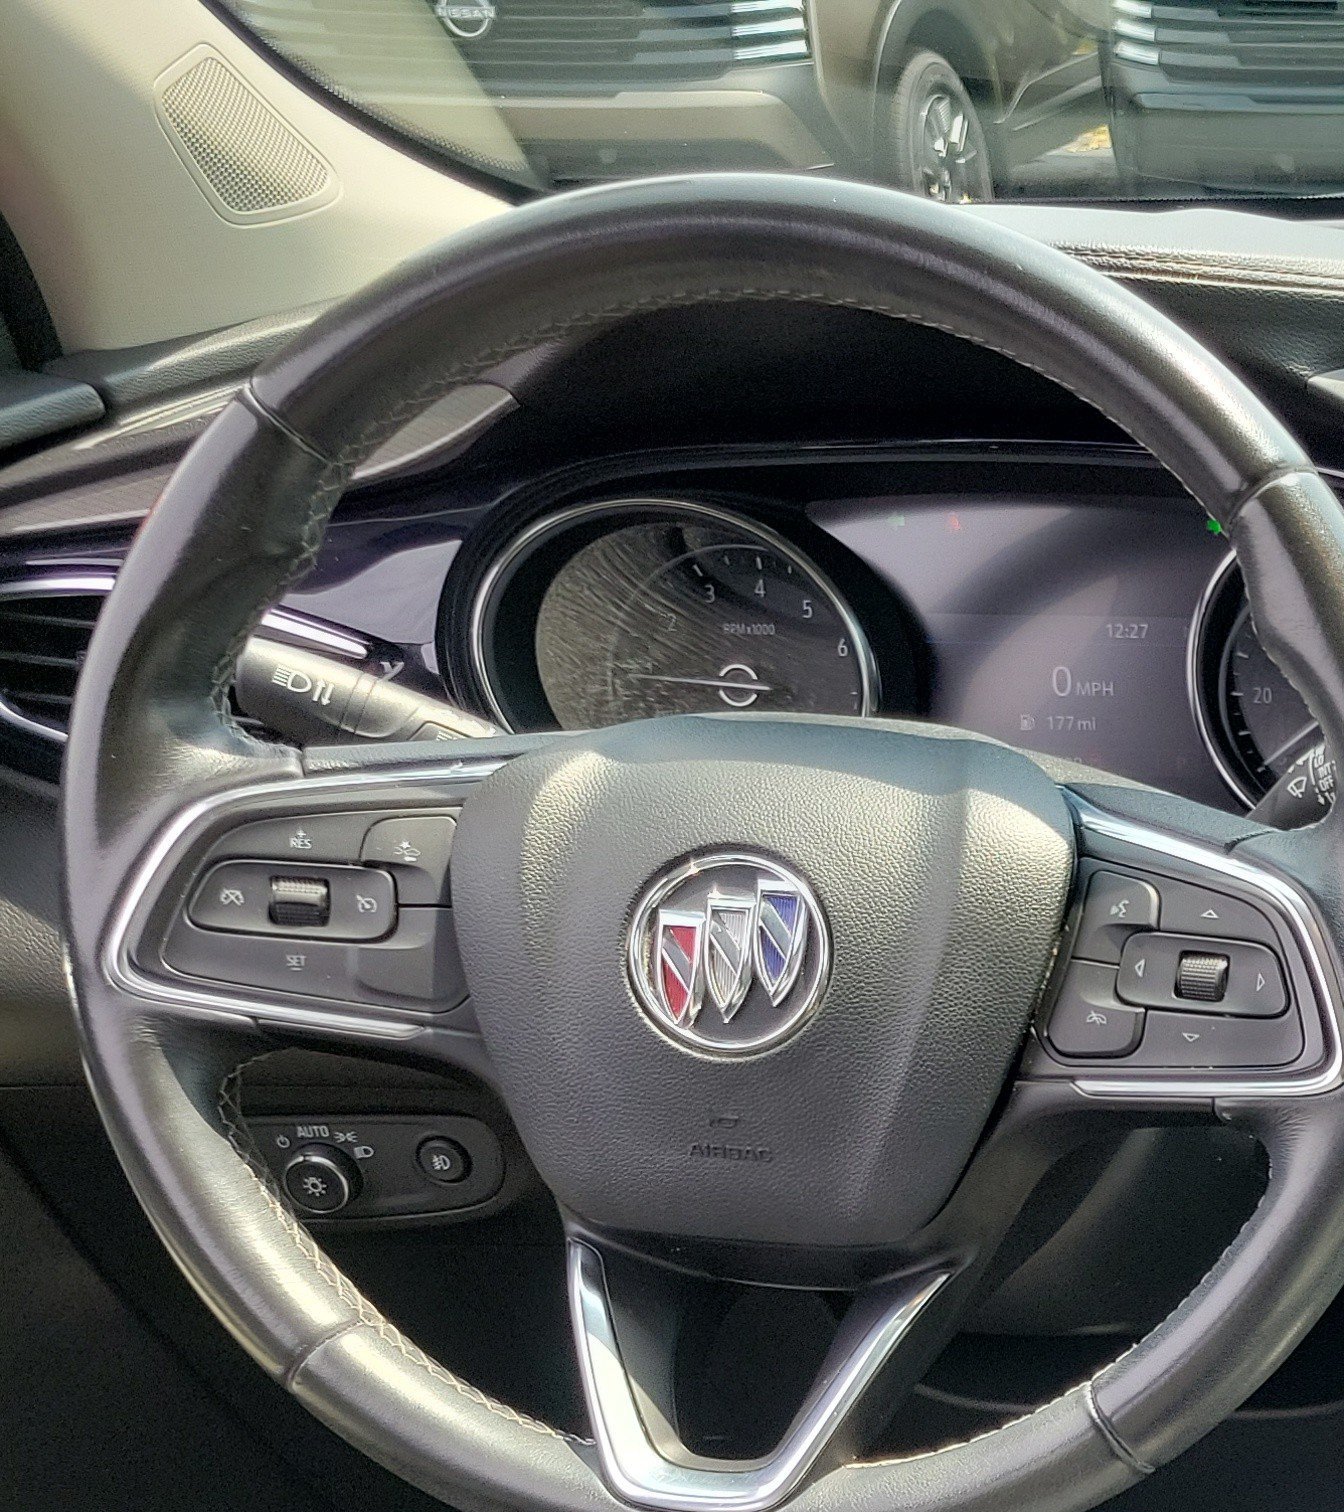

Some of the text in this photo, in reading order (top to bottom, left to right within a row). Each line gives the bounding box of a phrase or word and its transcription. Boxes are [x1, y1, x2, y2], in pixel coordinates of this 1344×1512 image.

[703, 584, 716, 603] 3
[753, 579, 767, 598] 4
[801, 600, 813, 619] 5
[1105, 623, 1149, 639] 12:27
[837, 638, 849, 657] 6
[1052, 666, 1115, 697] 0 MPH
[1253, 686, 1273, 704] 20
[1047, 716, 1097, 731] 177 mi
[1319, 775, 1335, 792] OFF
[296, 1125, 330, 1139] AUTO
